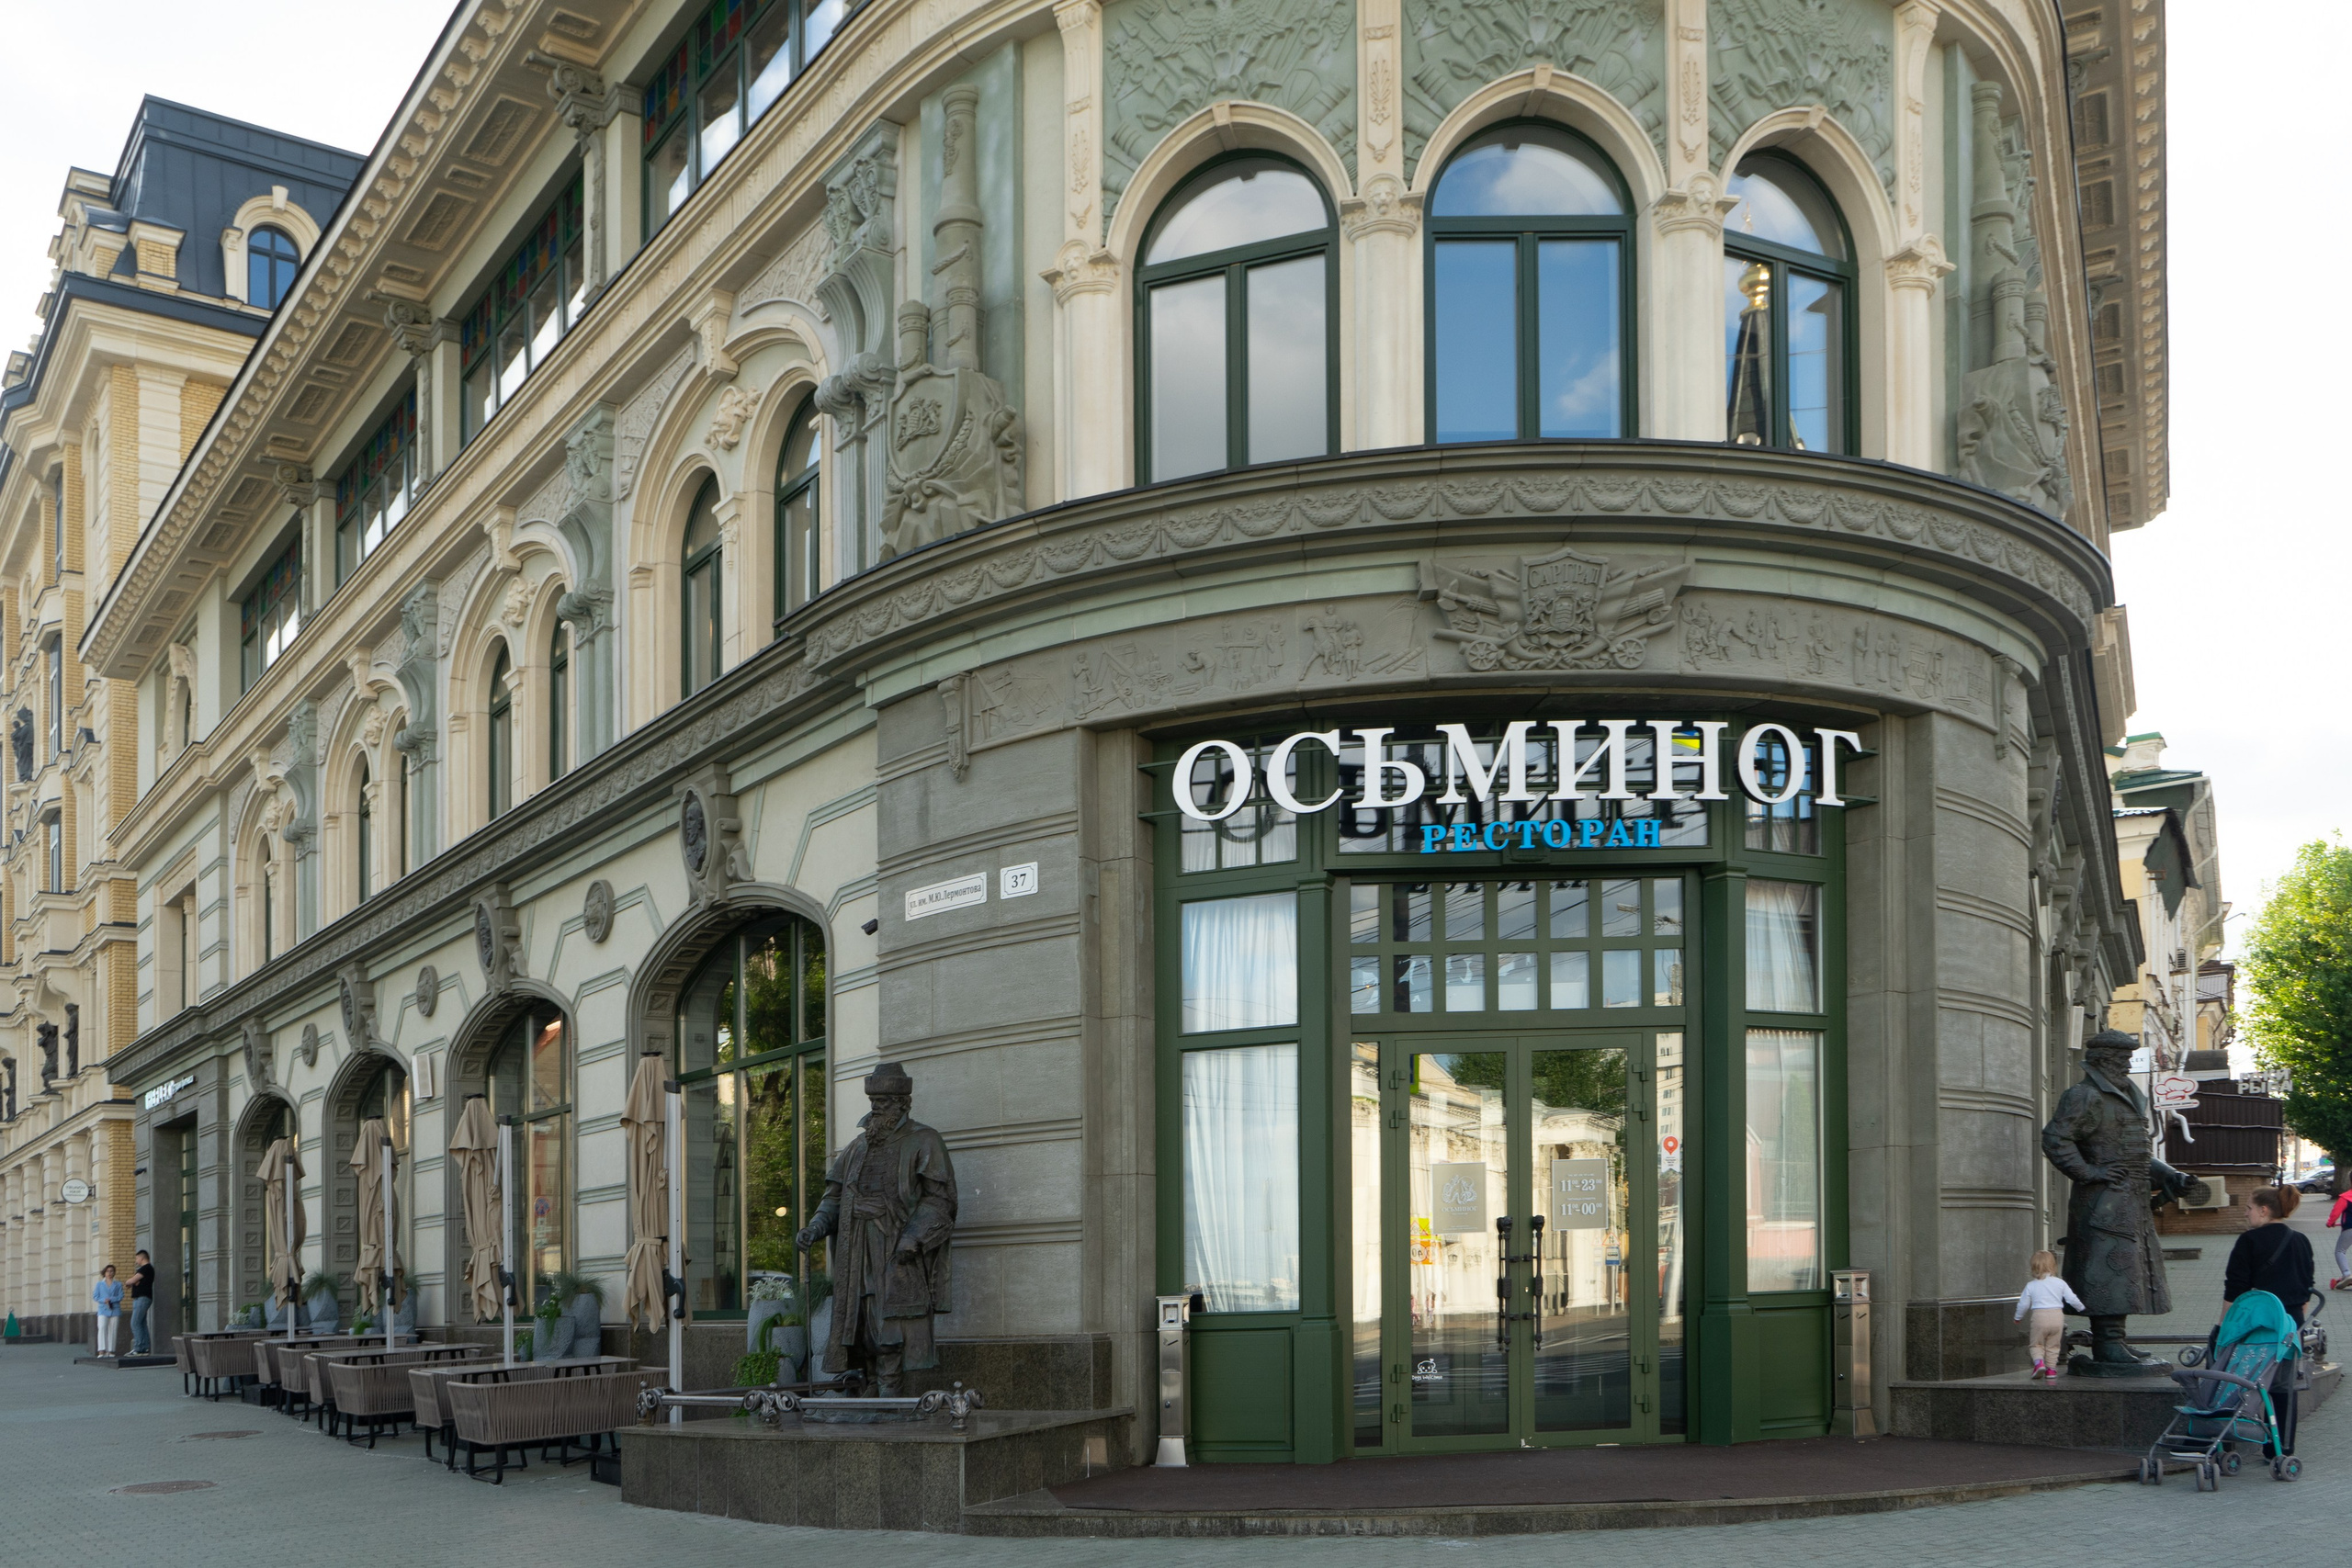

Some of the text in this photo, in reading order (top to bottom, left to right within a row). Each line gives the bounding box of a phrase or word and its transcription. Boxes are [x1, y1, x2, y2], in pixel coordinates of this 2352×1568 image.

[1172, 720, 1862, 821] ОСЬМИНОГ
[1419, 818, 1662, 854] РЕСТОРАН
[1012, 873, 1027, 888] 37
[2237, 1080, 2293, 1094] РЫБА
